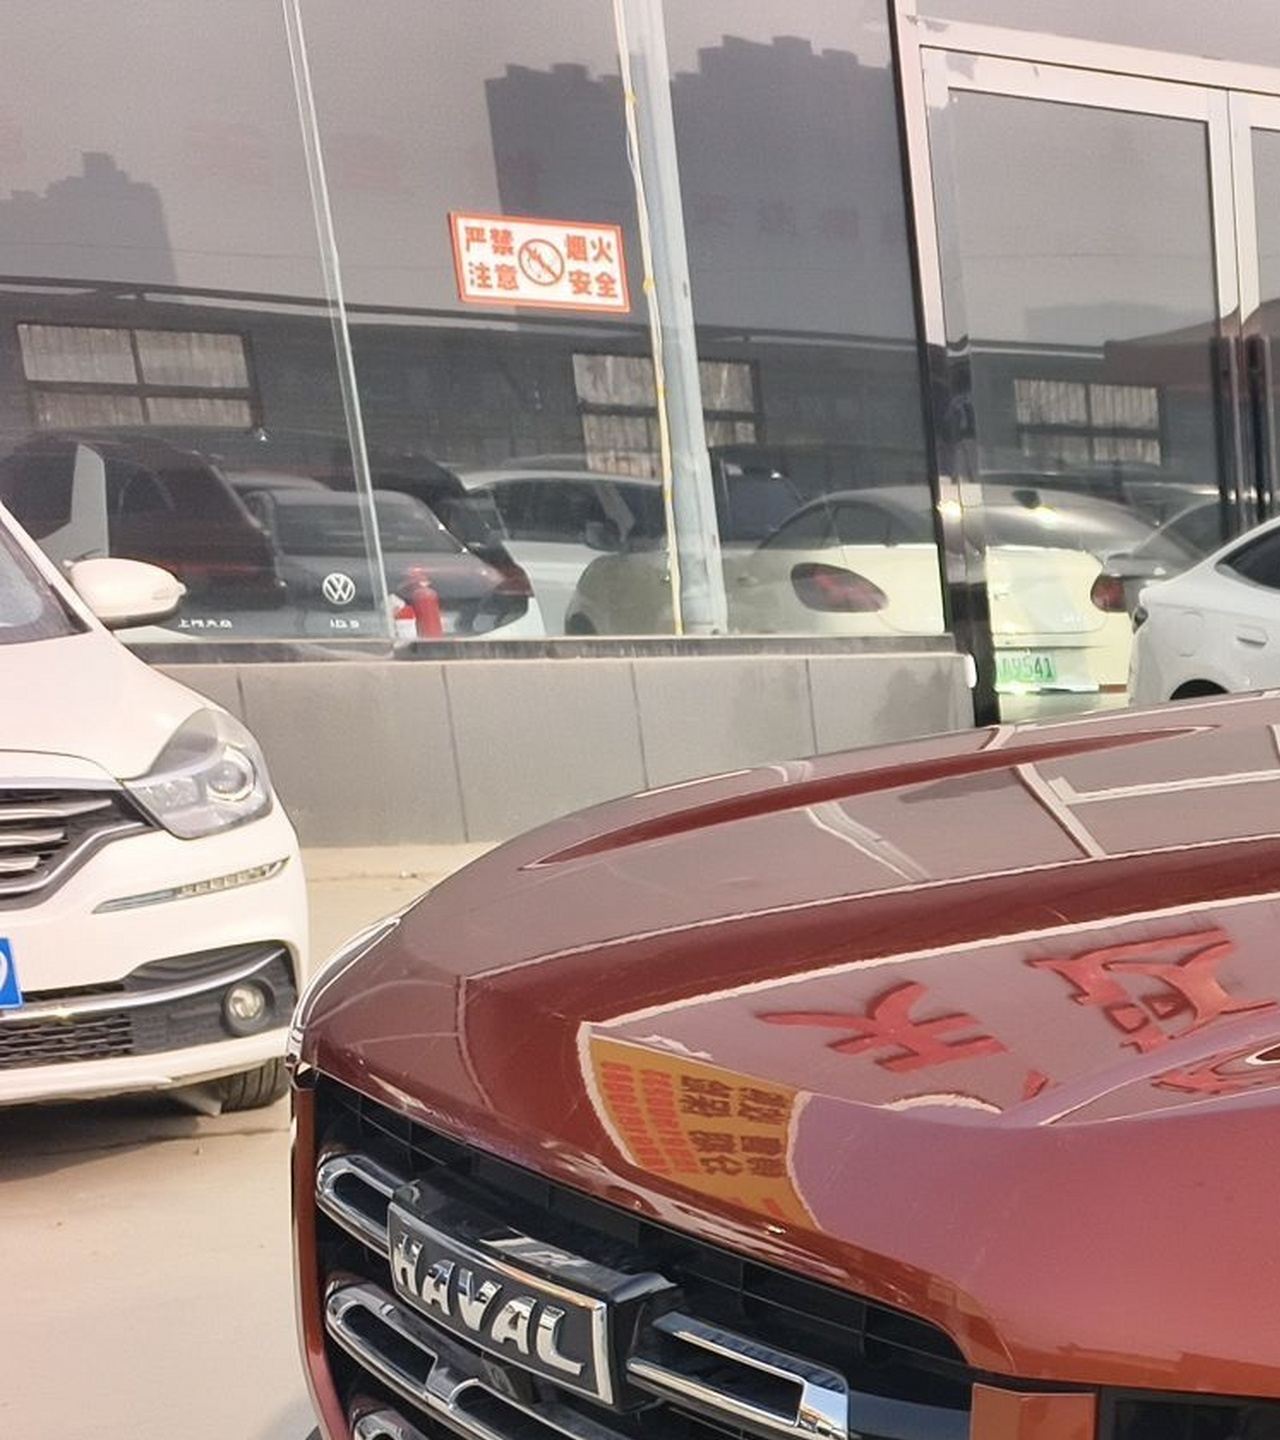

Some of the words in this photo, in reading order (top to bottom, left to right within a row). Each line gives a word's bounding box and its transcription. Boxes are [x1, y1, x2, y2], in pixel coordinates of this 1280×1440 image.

[465, 226, 514, 256] 严禁
[566, 233, 614, 264] 烟火
[468, 261, 520, 291] 注意
[568, 269, 619, 299] 安全
[393, 1232, 585, 1376] HAVAL
